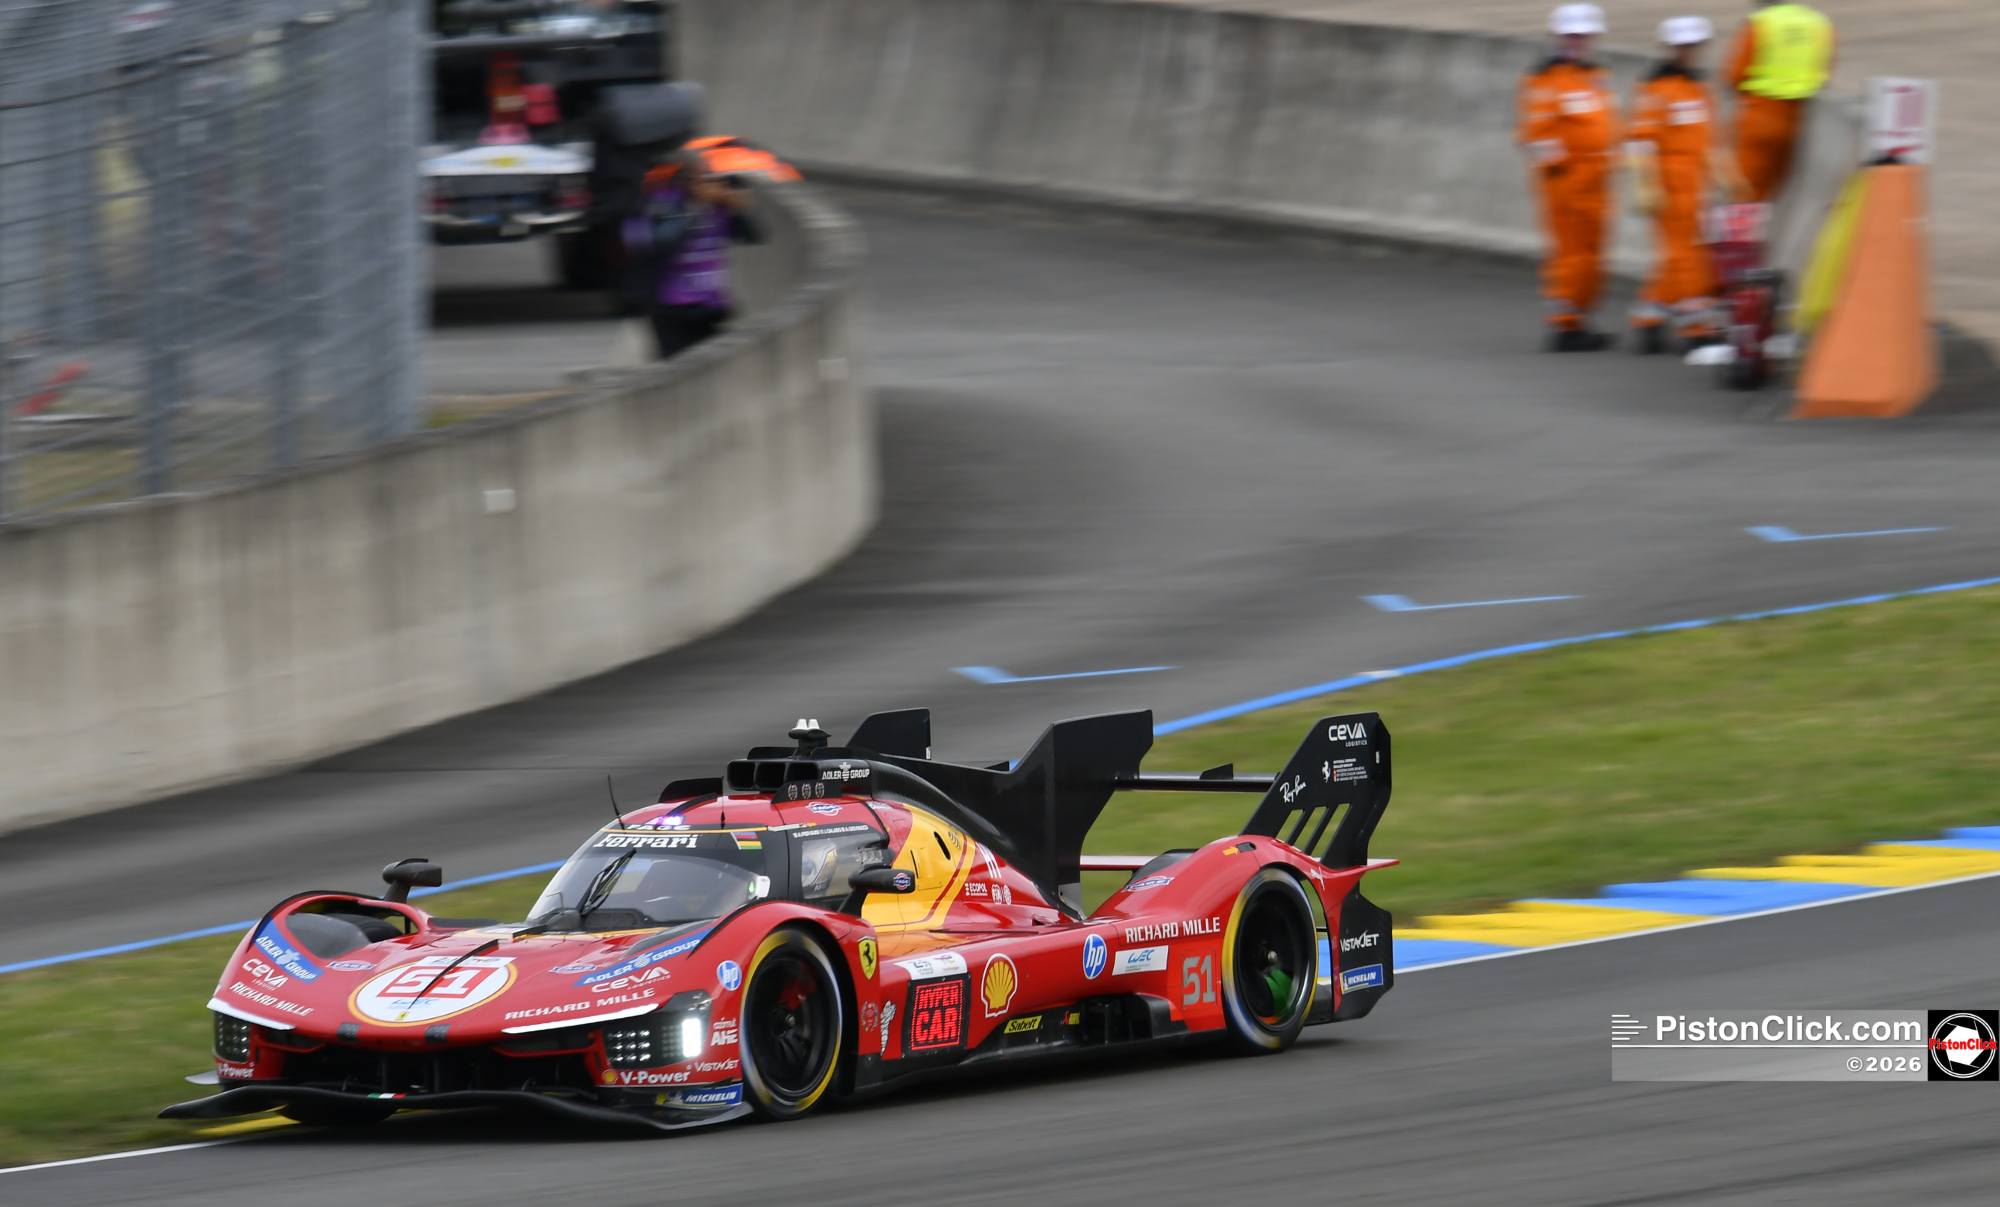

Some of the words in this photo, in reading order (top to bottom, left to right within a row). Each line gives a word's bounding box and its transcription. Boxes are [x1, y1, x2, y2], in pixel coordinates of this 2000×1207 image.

[1345, 739, 1368, 748] LOGISTICS
[822, 770, 842, 780] ADLER
[850, 768, 870, 779] GROUP
[593, 833, 700, 848] Ferrari
[969, 882, 988, 893] ECOPOL
[1125, 921, 1179, 944] RICHARD
[1182, 916, 1221, 936] MILLE
[255, 935, 284, 958] ADLER
[284, 961, 317, 980] GROUP
[582, 964, 634, 984] ADLER
[652, 939, 701, 962] GROUP
[1084, 934, 1106, 979] hp
[1127, 949, 1155, 964] WEC
[385, 968, 482, 995] 51
[720, 960, 739, 991] hp
[1183, 954, 1217, 1006] 51
[1347, 971, 1377, 986] MICHELIN
[229, 981, 279, 1006] RICHARD
[272, 1000, 315, 1016] MILLE
[504, 1001, 591, 1021] RICHARD
[596, 987, 656, 1007] MILLE
[918, 984, 959, 1010] HYPER
[712, 1017, 737, 1030] azimut
[915, 1006, 959, 1044] CAR
[620, 1071, 691, 1085] V-Power
[685, 1091, 738, 1103] MICHELIN
